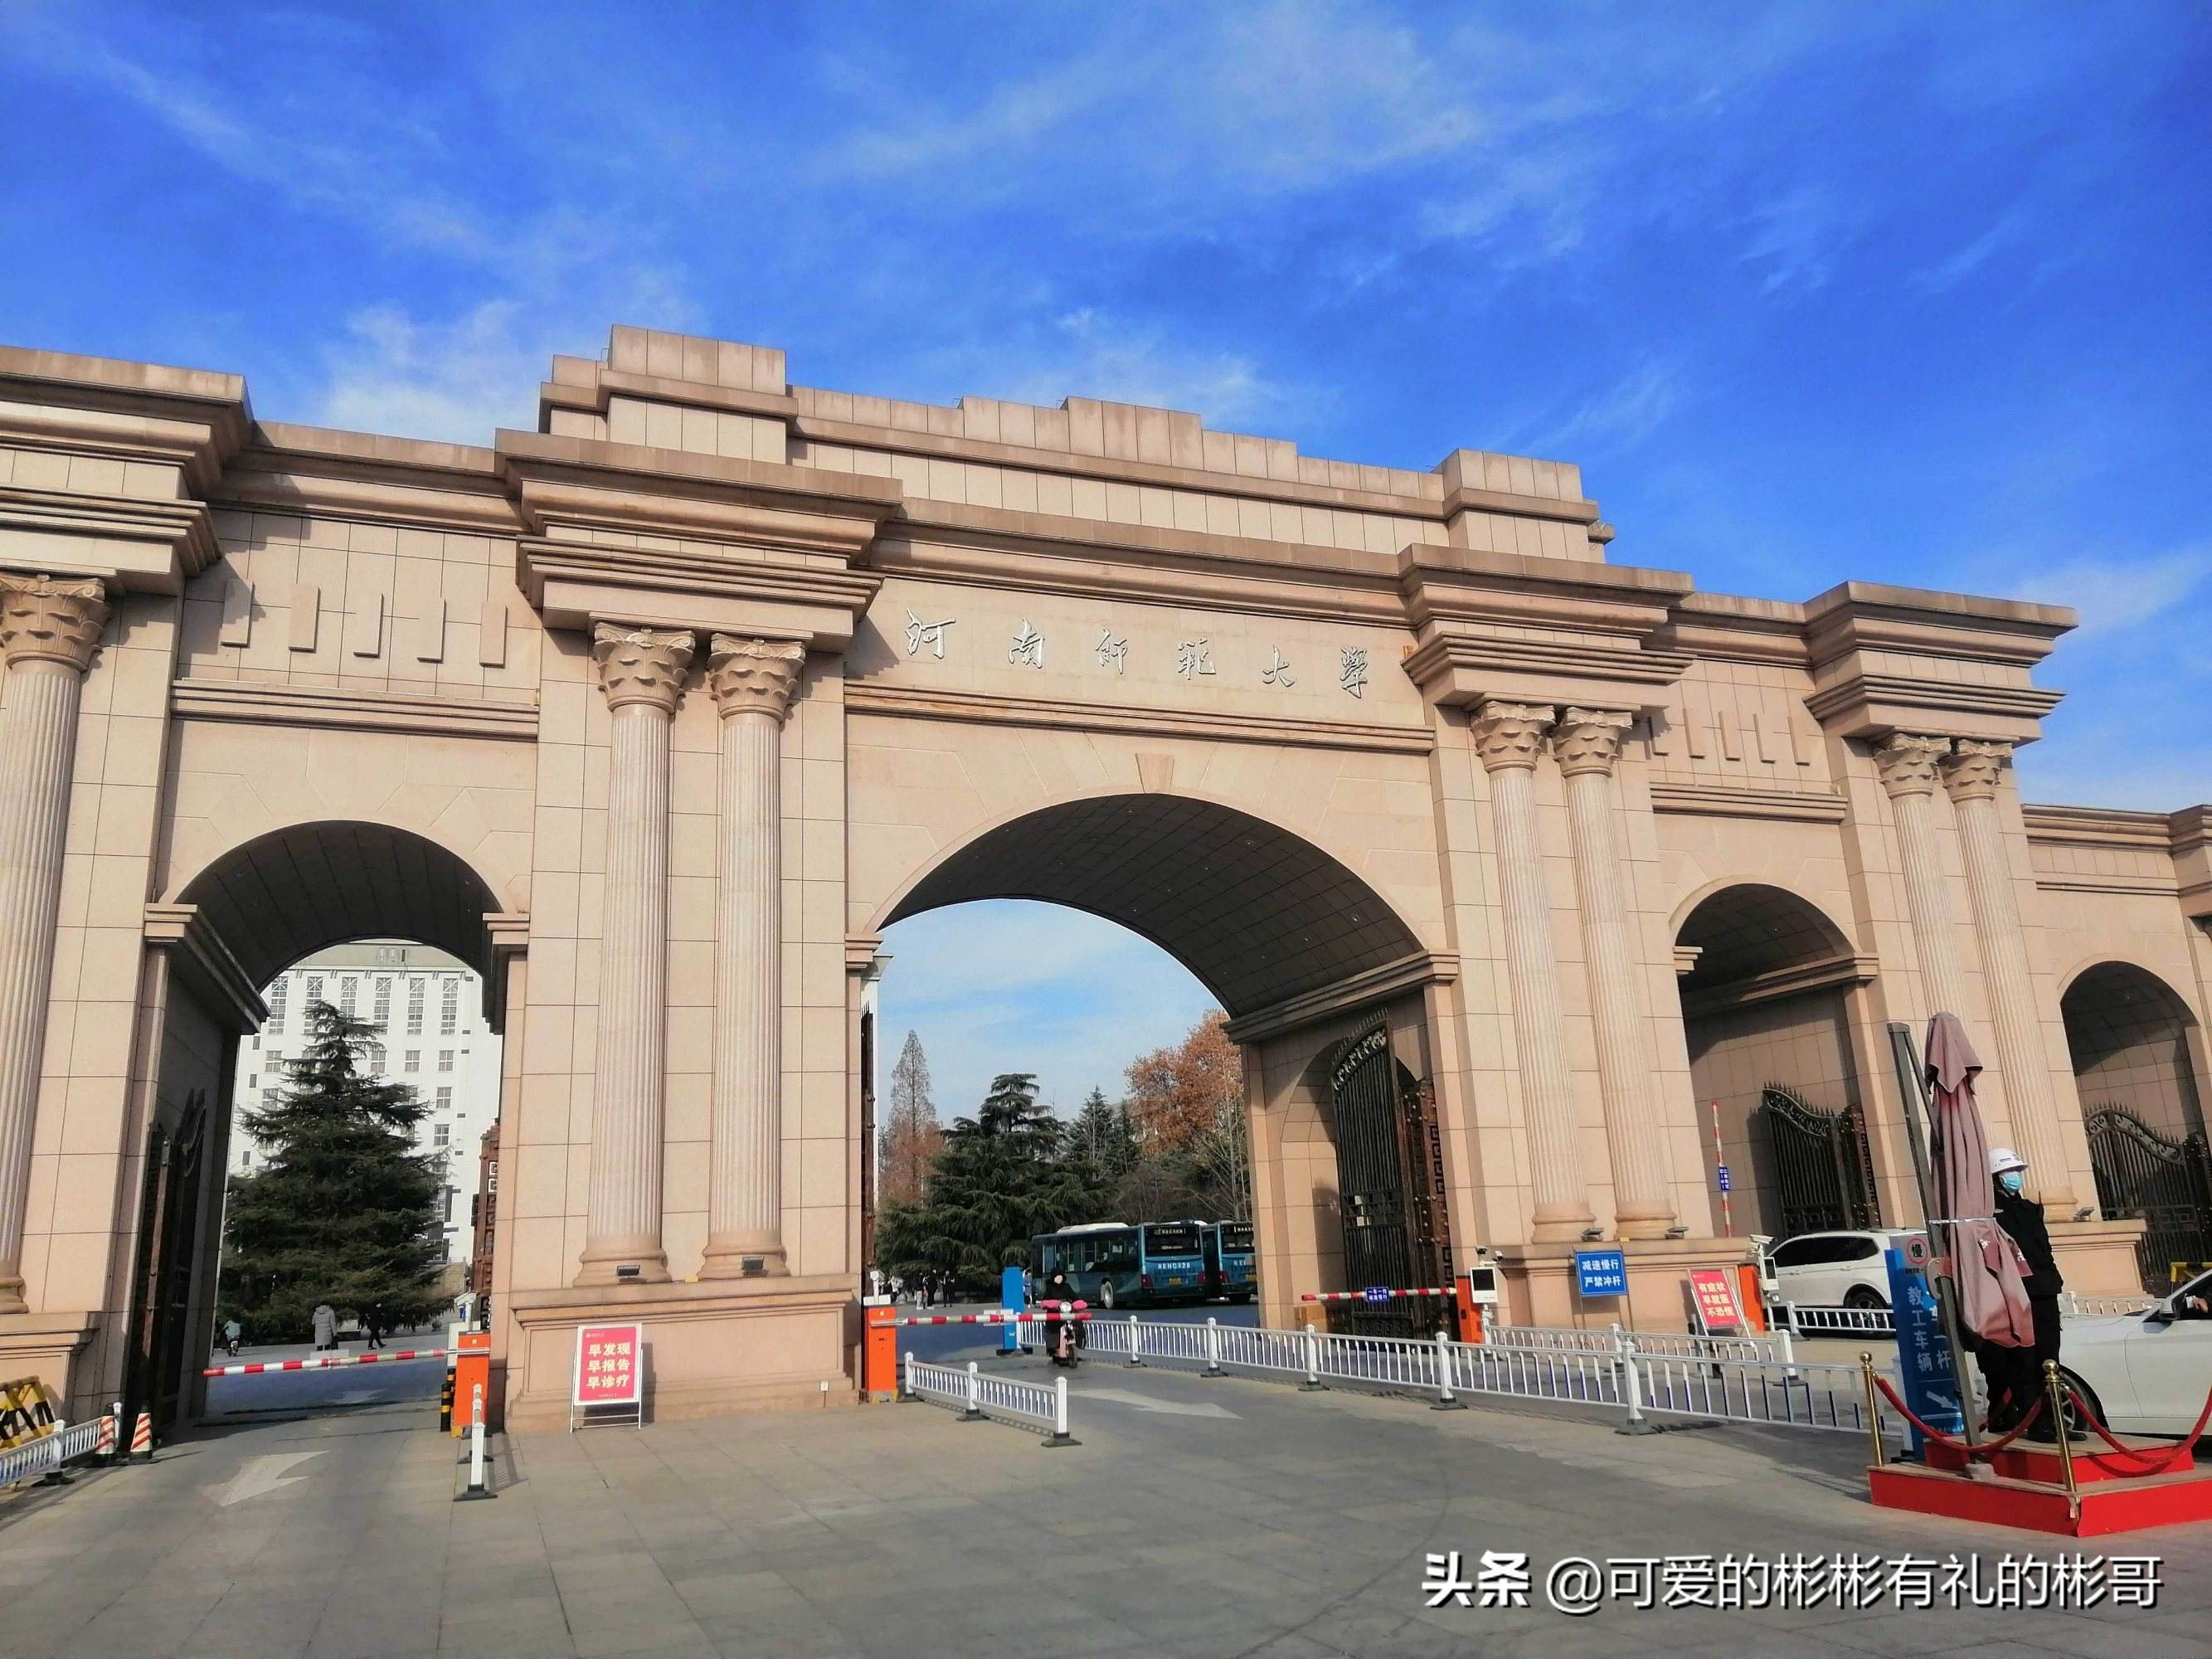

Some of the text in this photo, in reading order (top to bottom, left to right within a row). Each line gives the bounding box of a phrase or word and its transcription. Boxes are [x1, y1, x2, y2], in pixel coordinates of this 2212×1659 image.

[1582, 1258, 1620, 1271] 减速慢行
[1584, 1275, 1621, 1287] 严禁冲杆
[1908, 1286, 1932, 1372] 教工车辆
[588, 1341, 630, 1358] 早发现
[586, 1357, 630, 1374] 早报告
[586, 1374, 630, 1390] 早诊疗
